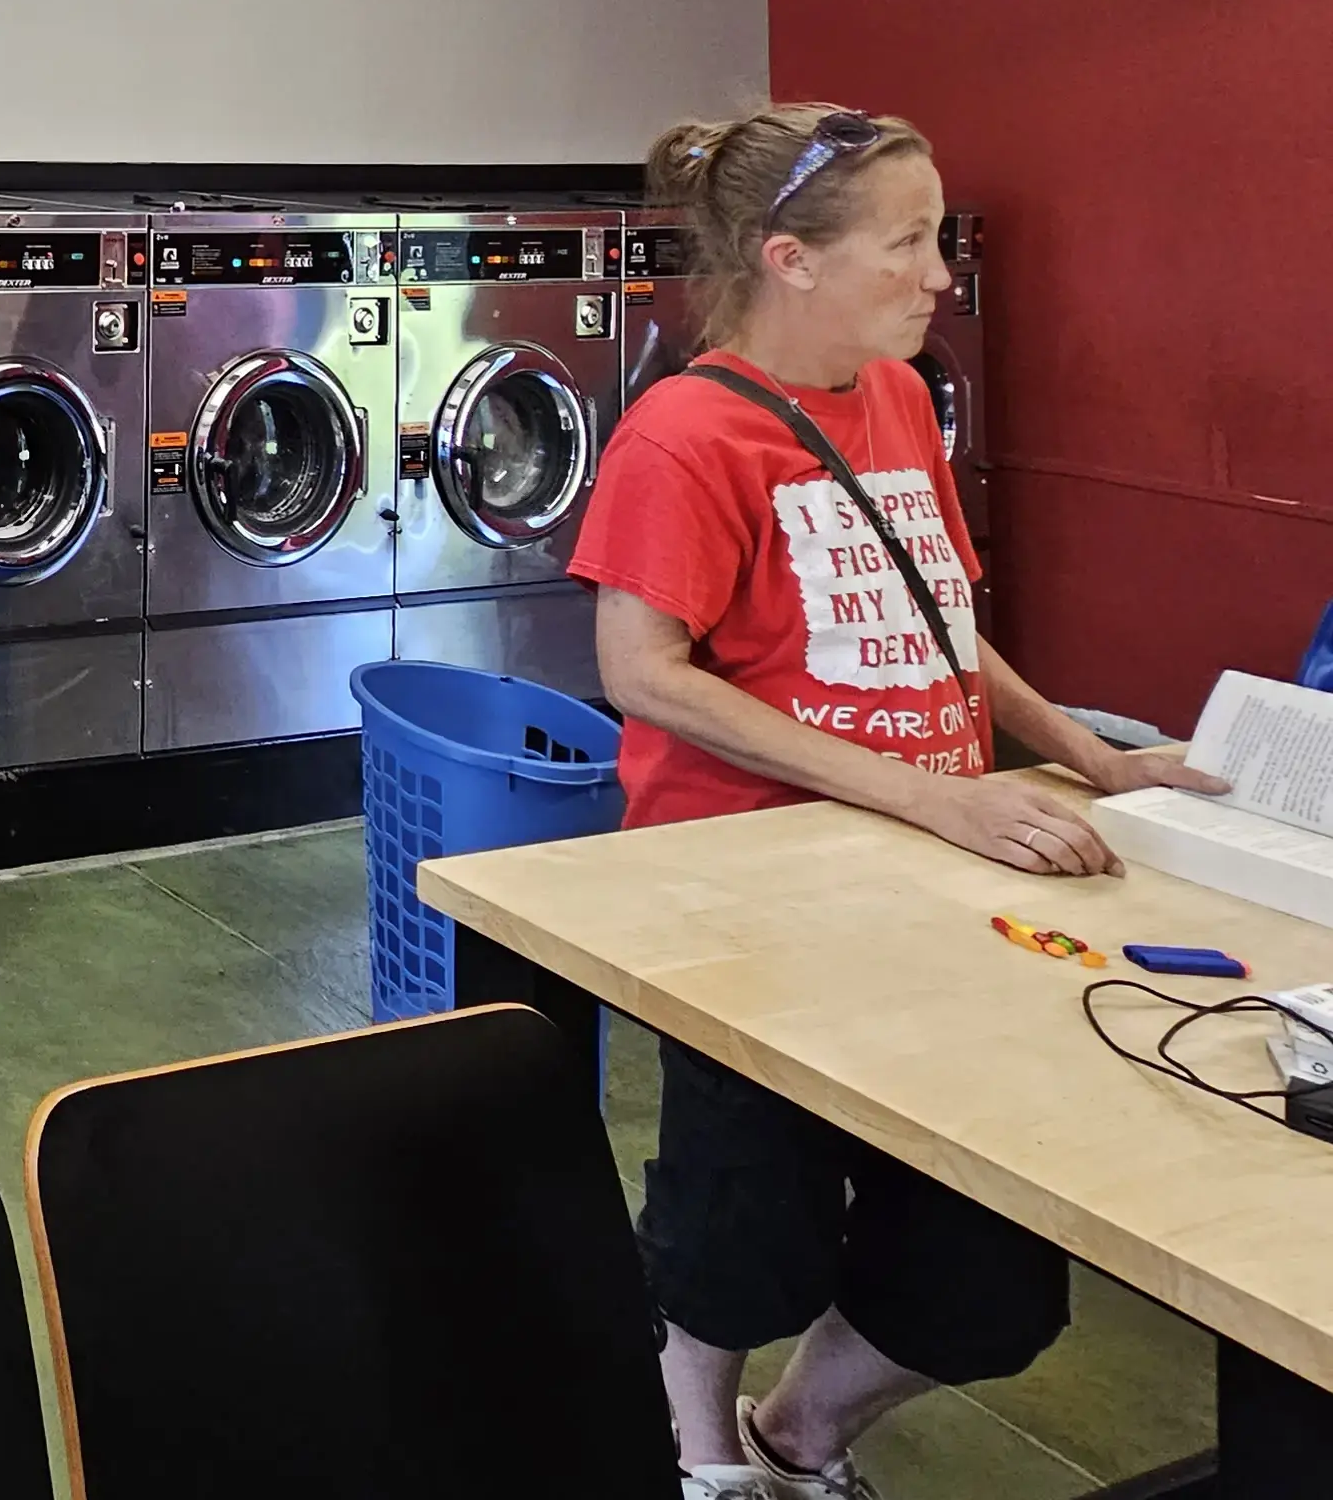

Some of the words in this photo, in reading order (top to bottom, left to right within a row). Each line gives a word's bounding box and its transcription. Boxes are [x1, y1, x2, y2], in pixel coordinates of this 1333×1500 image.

[262, 276, 294, 284] DEXTER
[498, 272, 528, 280] DEXTER
[797, 504, 818, 535] I
[835, 490, 941, 530] STPPED
[829, 587, 886, 625] MY
[792, 697, 859, 730] WE
[865, 707, 934, 740] ARE
[939, 701, 966, 736] ON
[915, 747, 963, 775] SIDE
